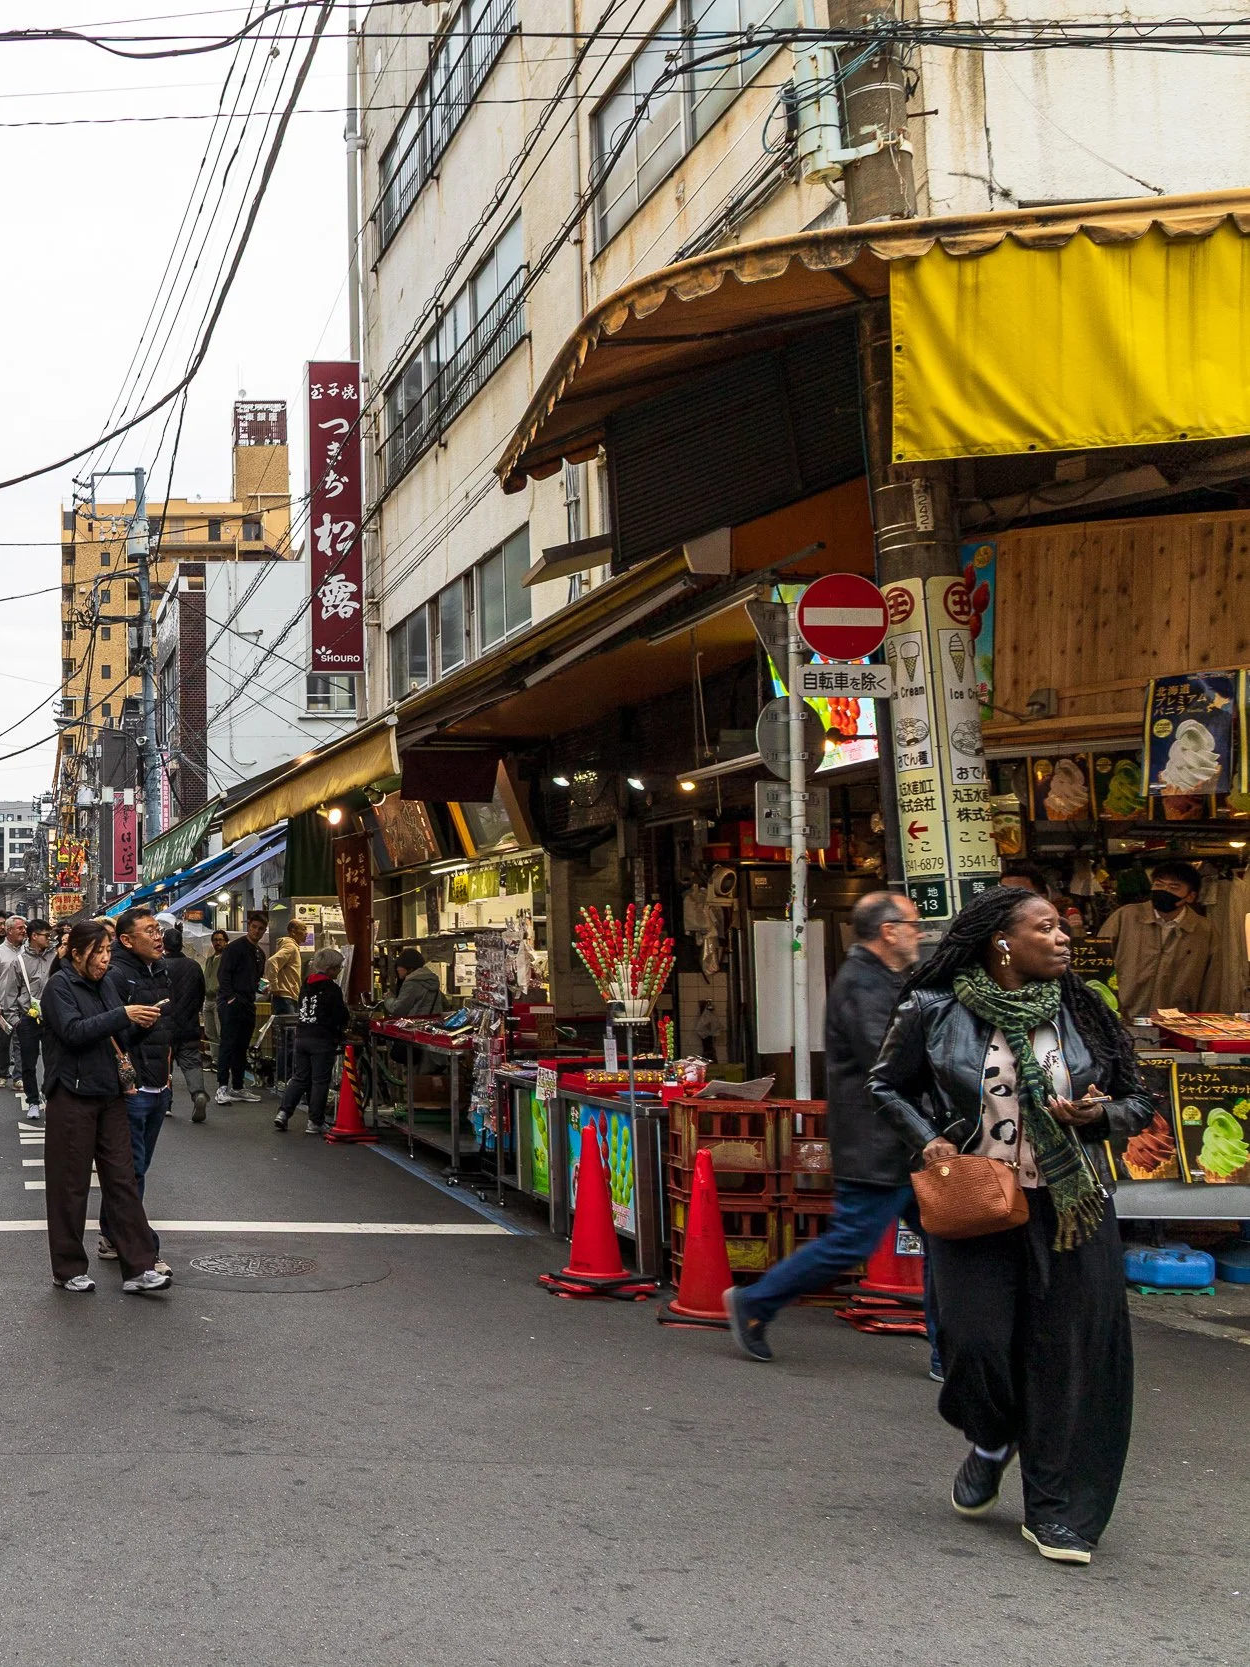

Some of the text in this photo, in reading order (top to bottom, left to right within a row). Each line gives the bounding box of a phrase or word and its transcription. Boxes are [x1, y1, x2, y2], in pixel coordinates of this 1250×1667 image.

[310, 383, 358, 400] 玉子焼
[313, 417, 361, 621] つきぢ 松露
[320, 654, 361, 663] SHOURO
[803, 674, 887, 691] 自転車を除く
[900, 685, 925, 698] Cream
[950, 687, 964, 700] Ice
[1156, 683, 1191, 697] 北海道
[1154, 693, 1208, 707] プレミアム
[1154, 706, 1186, 717] バニラ
[959, 831, 988, 843] ここ
[907, 840, 932, 854] ここ
[958, 854, 999, 868] 3541-6
[1071, 957, 1114, 966] インマスカ
[1178, 1072, 1221, 1082] プレミアム
[1179, 1084, 1250, 1094] シャインマスカット
